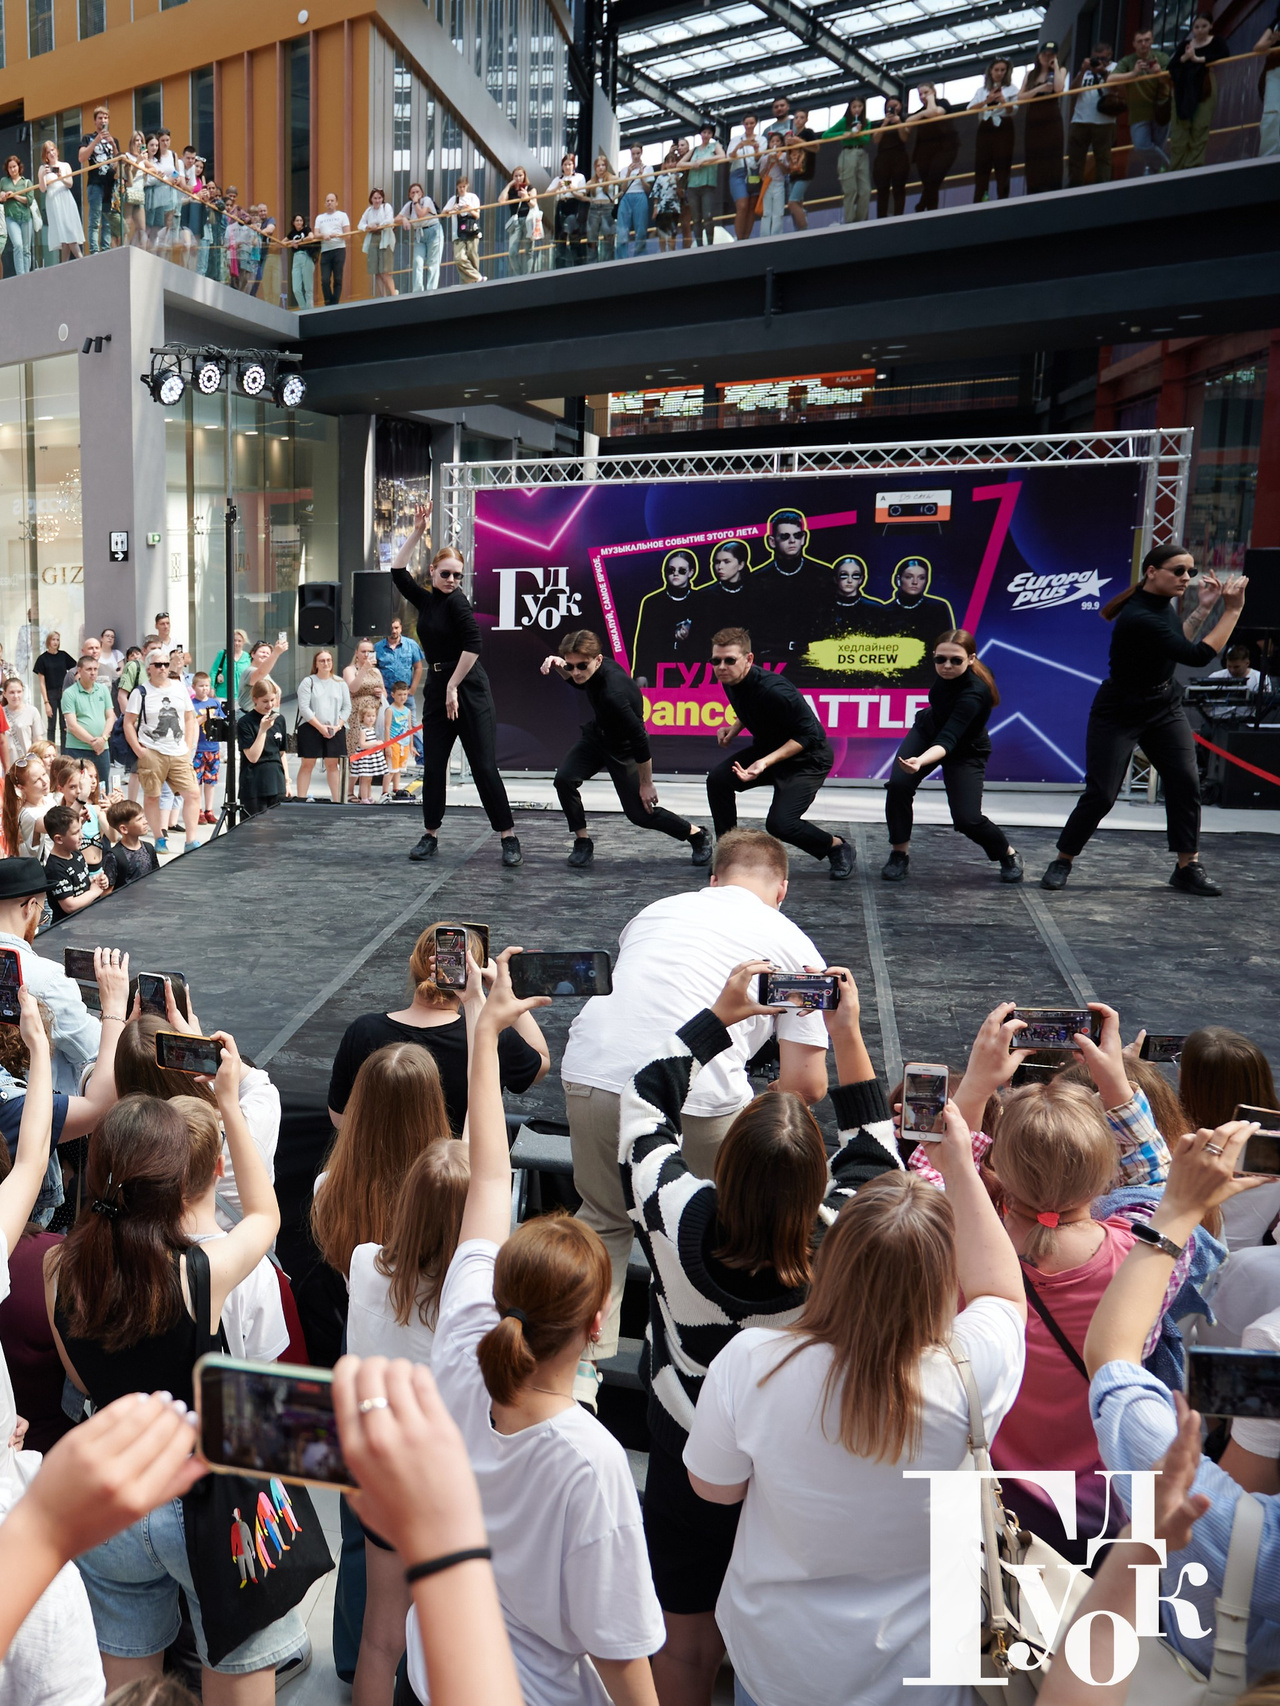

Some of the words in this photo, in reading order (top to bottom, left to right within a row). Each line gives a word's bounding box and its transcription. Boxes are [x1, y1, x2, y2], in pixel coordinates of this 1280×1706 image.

[601, 541, 664, 555] МУЗЫКАЛЬНОЕ
[665, 535, 706, 546] СОБЫТИЕ
[706, 531, 735, 541] ЭТОГО
[735, 526, 758, 537] ЛЕТА
[42, 566, 84, 585] GIZ
[593, 554, 605, 584] ЯРКОЕ,
[600, 583, 612, 610] САМОЕ
[1081, 601, 1100, 610] 99.9
[605, 610, 622, 653] ПОЖАЛУЙ,
[838, 643, 899, 653] хедлайнер
[838, 654, 855, 664] DS
[859, 654, 898, 664] CREW
